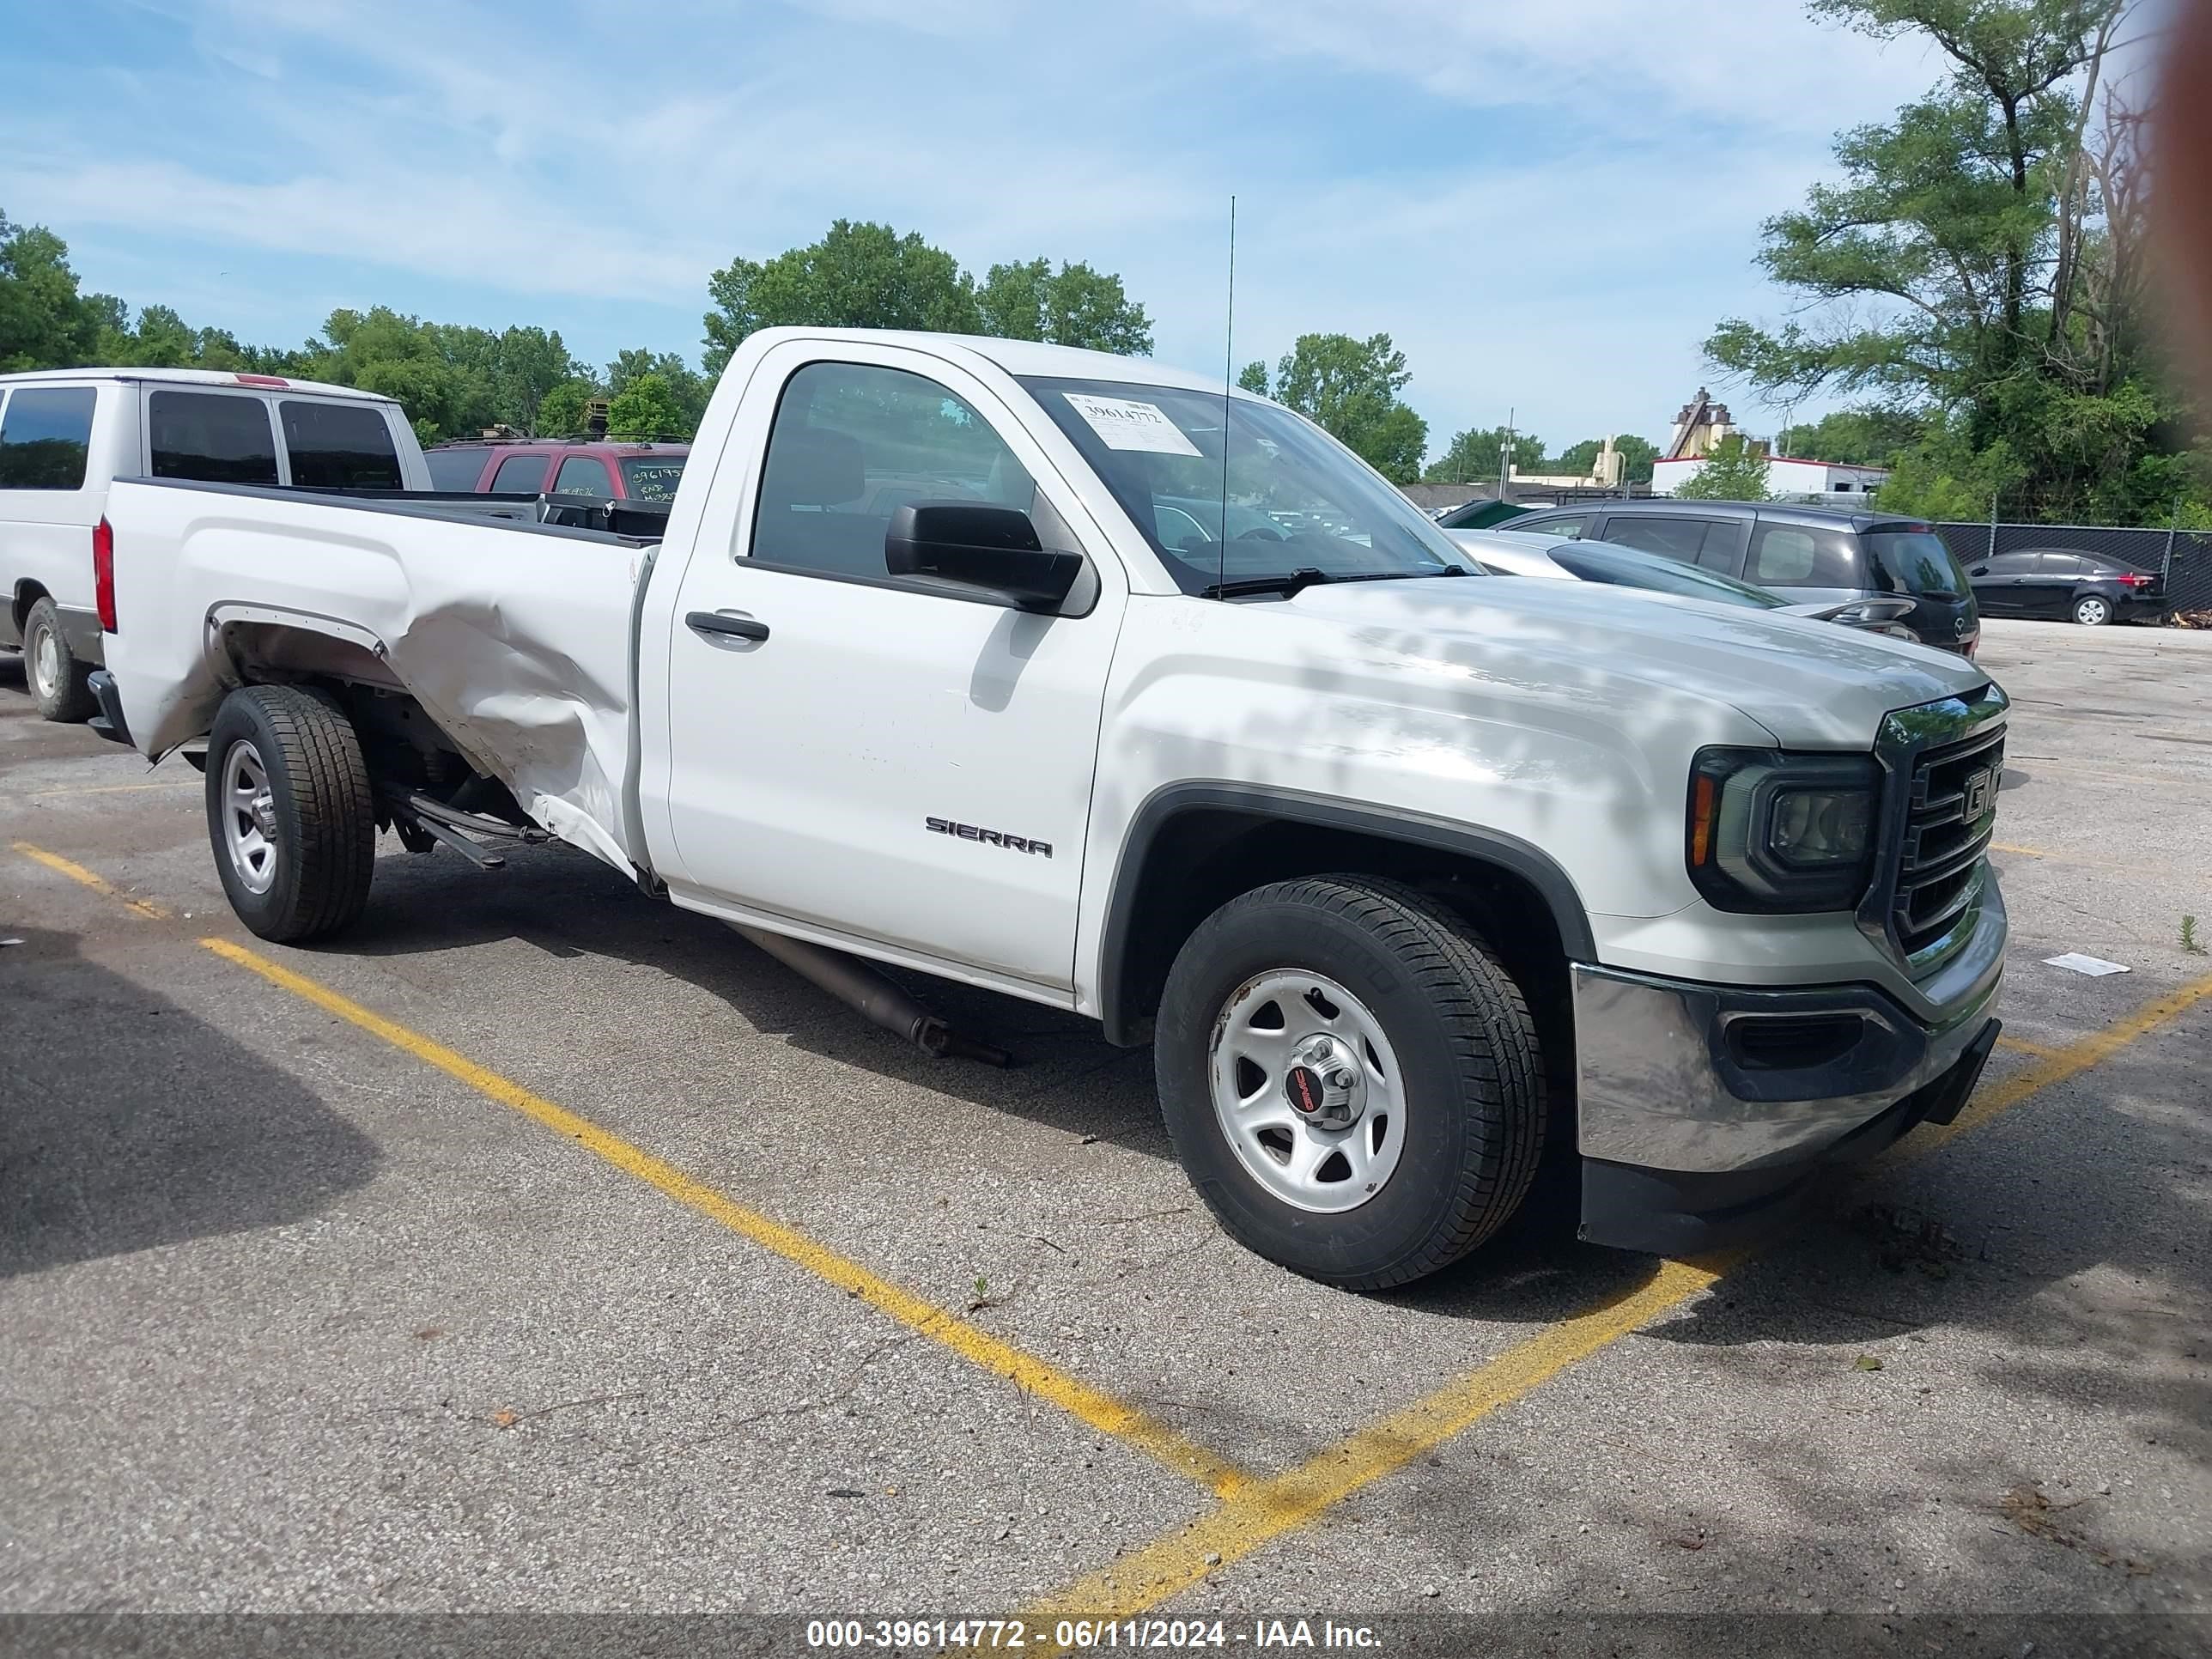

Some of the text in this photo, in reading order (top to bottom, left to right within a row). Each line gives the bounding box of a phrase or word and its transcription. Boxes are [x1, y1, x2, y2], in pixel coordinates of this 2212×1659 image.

[1085, 405, 1162, 423] 39614772
[926, 816, 1054, 860] SIERRA
[1295, 1069, 1314, 1110] GMC
